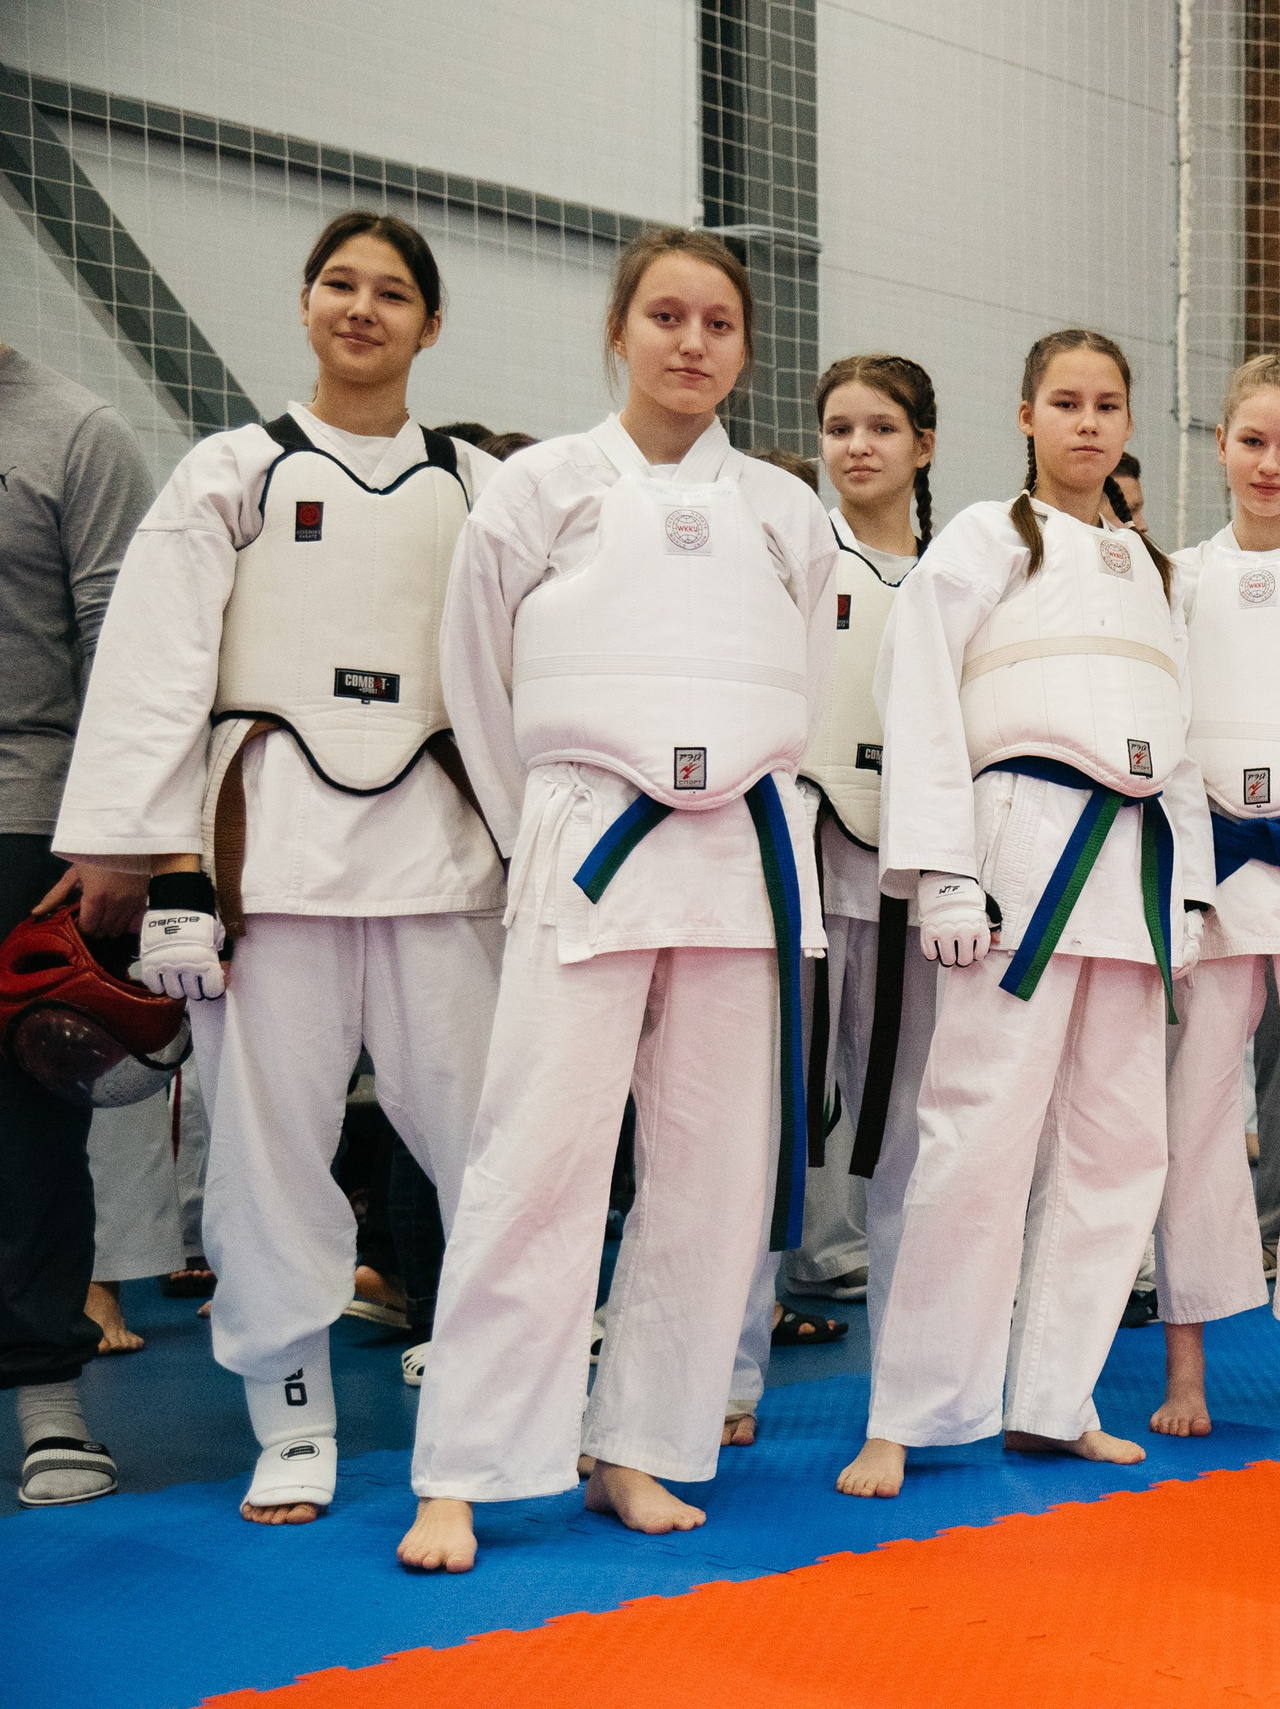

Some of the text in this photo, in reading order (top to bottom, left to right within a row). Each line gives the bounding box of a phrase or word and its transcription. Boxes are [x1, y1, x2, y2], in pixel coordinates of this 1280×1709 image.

[676, 524, 699, 533] WKKU
[344, 674, 388, 690] COMBT
[148, 916, 200, 928] BOYBO
